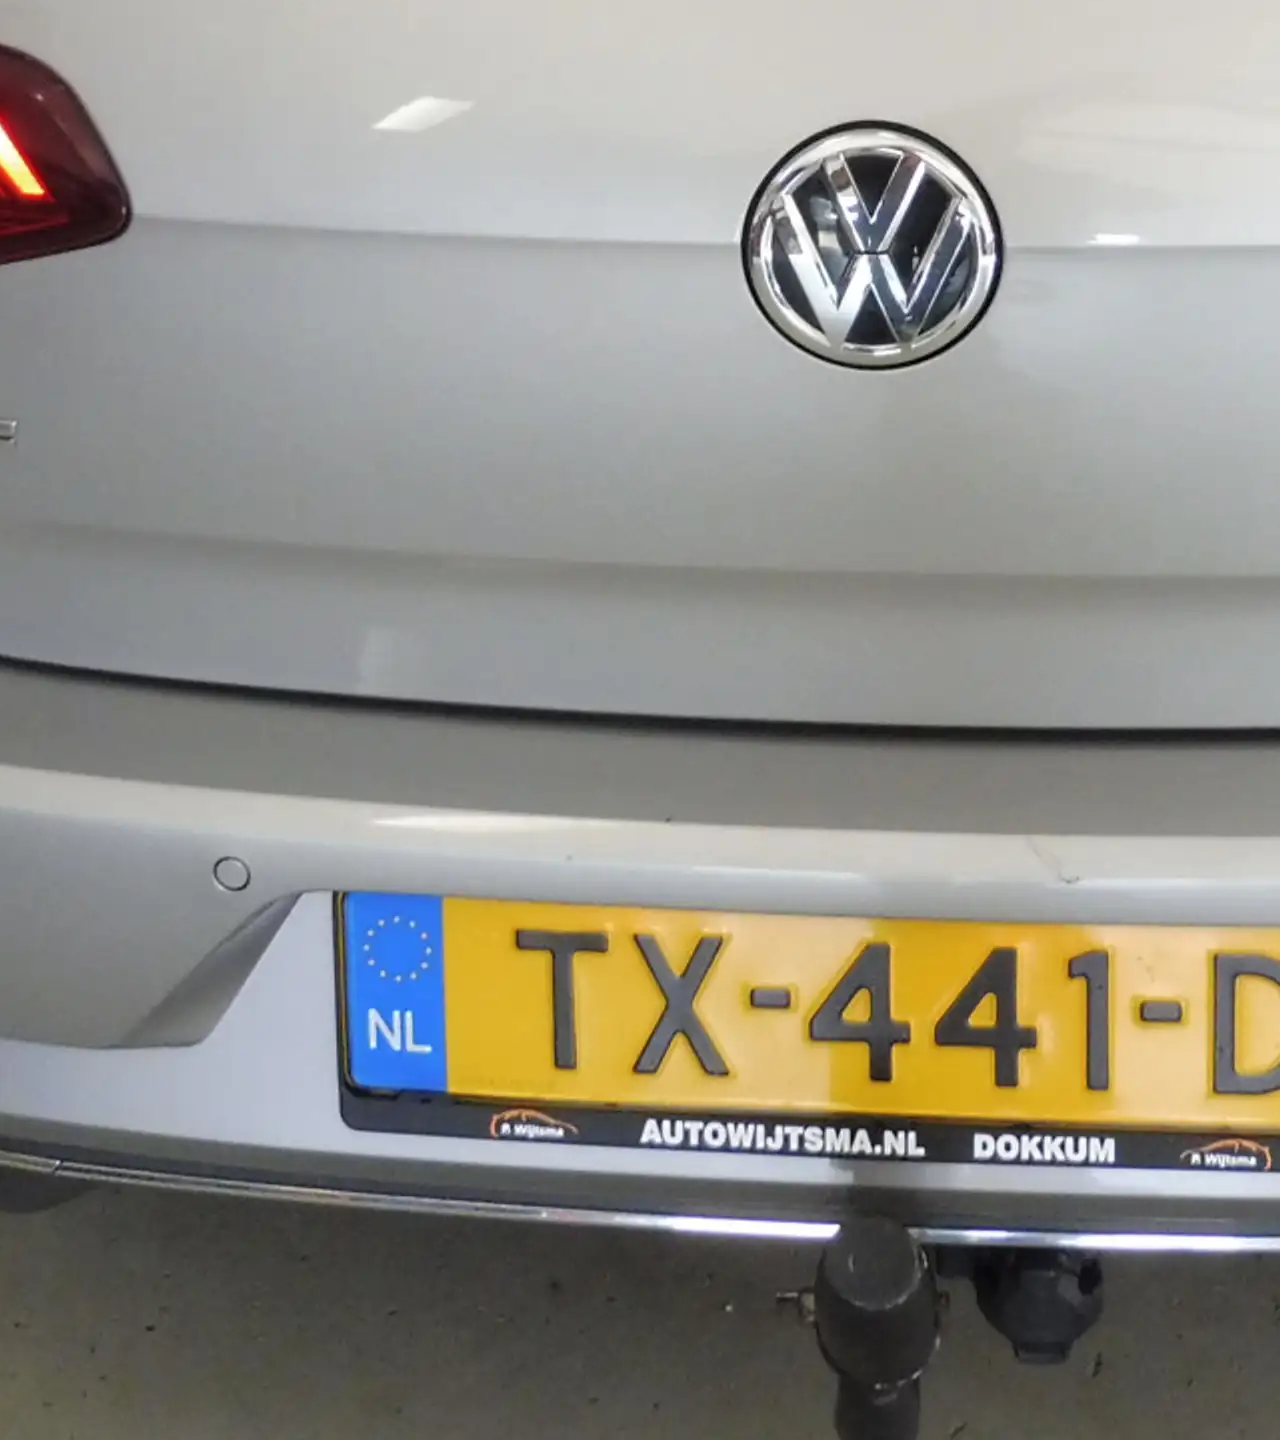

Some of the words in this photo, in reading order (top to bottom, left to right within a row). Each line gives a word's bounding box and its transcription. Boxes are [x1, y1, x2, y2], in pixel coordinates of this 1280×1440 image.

[367, 1007, 433, 1054] NL
[639, 1117, 926, 1157] AUTOWIJTSMA.NL
[972, 1132, 1117, 1164] DOKKUM
